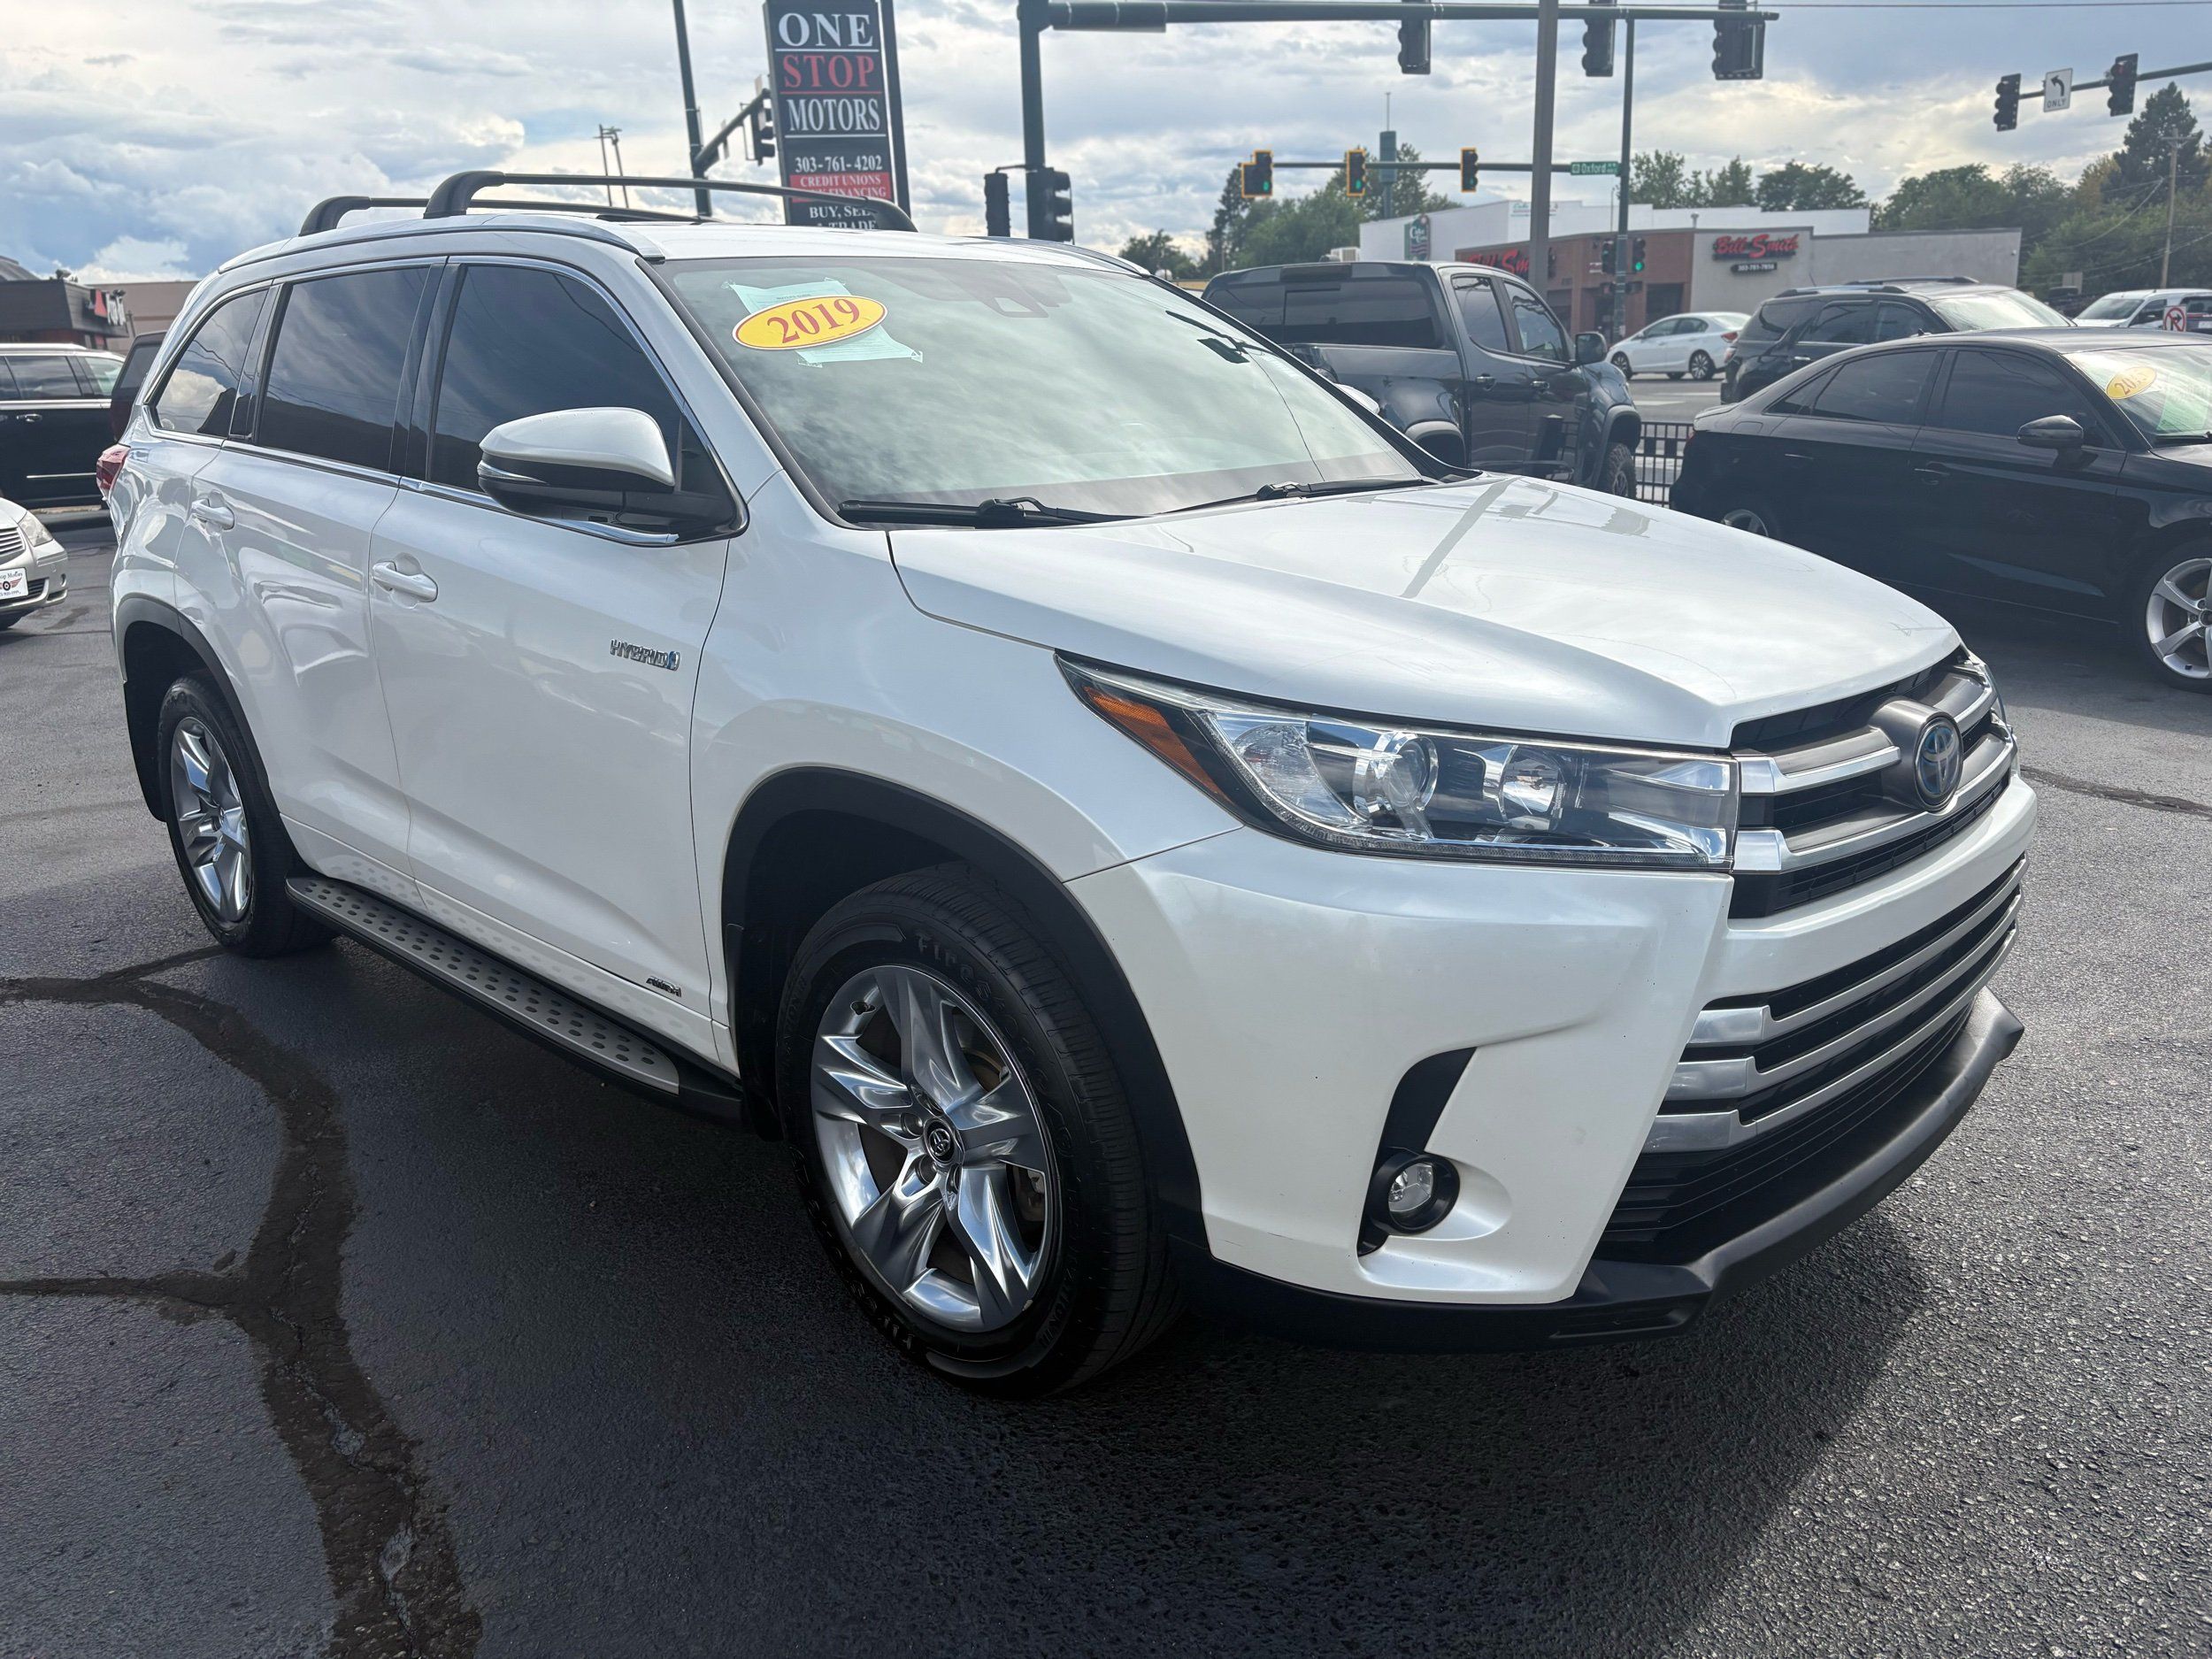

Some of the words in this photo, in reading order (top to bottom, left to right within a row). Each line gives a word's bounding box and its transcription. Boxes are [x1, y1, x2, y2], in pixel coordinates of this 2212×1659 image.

[779, 12, 873, 47] ONE
[783, 54, 874, 88] STOP
[787, 98, 880, 131] MOTORS
[2047, 98, 2067, 108] ONLY
[800, 176, 840, 187] CREDIT
[841, 174, 881, 186] UNIONS
[809, 205, 841, 219] BUY,
[843, 205, 872, 217] SEL
[767, 298, 860, 343] 2019
[610, 638, 668, 667] HYBRID
